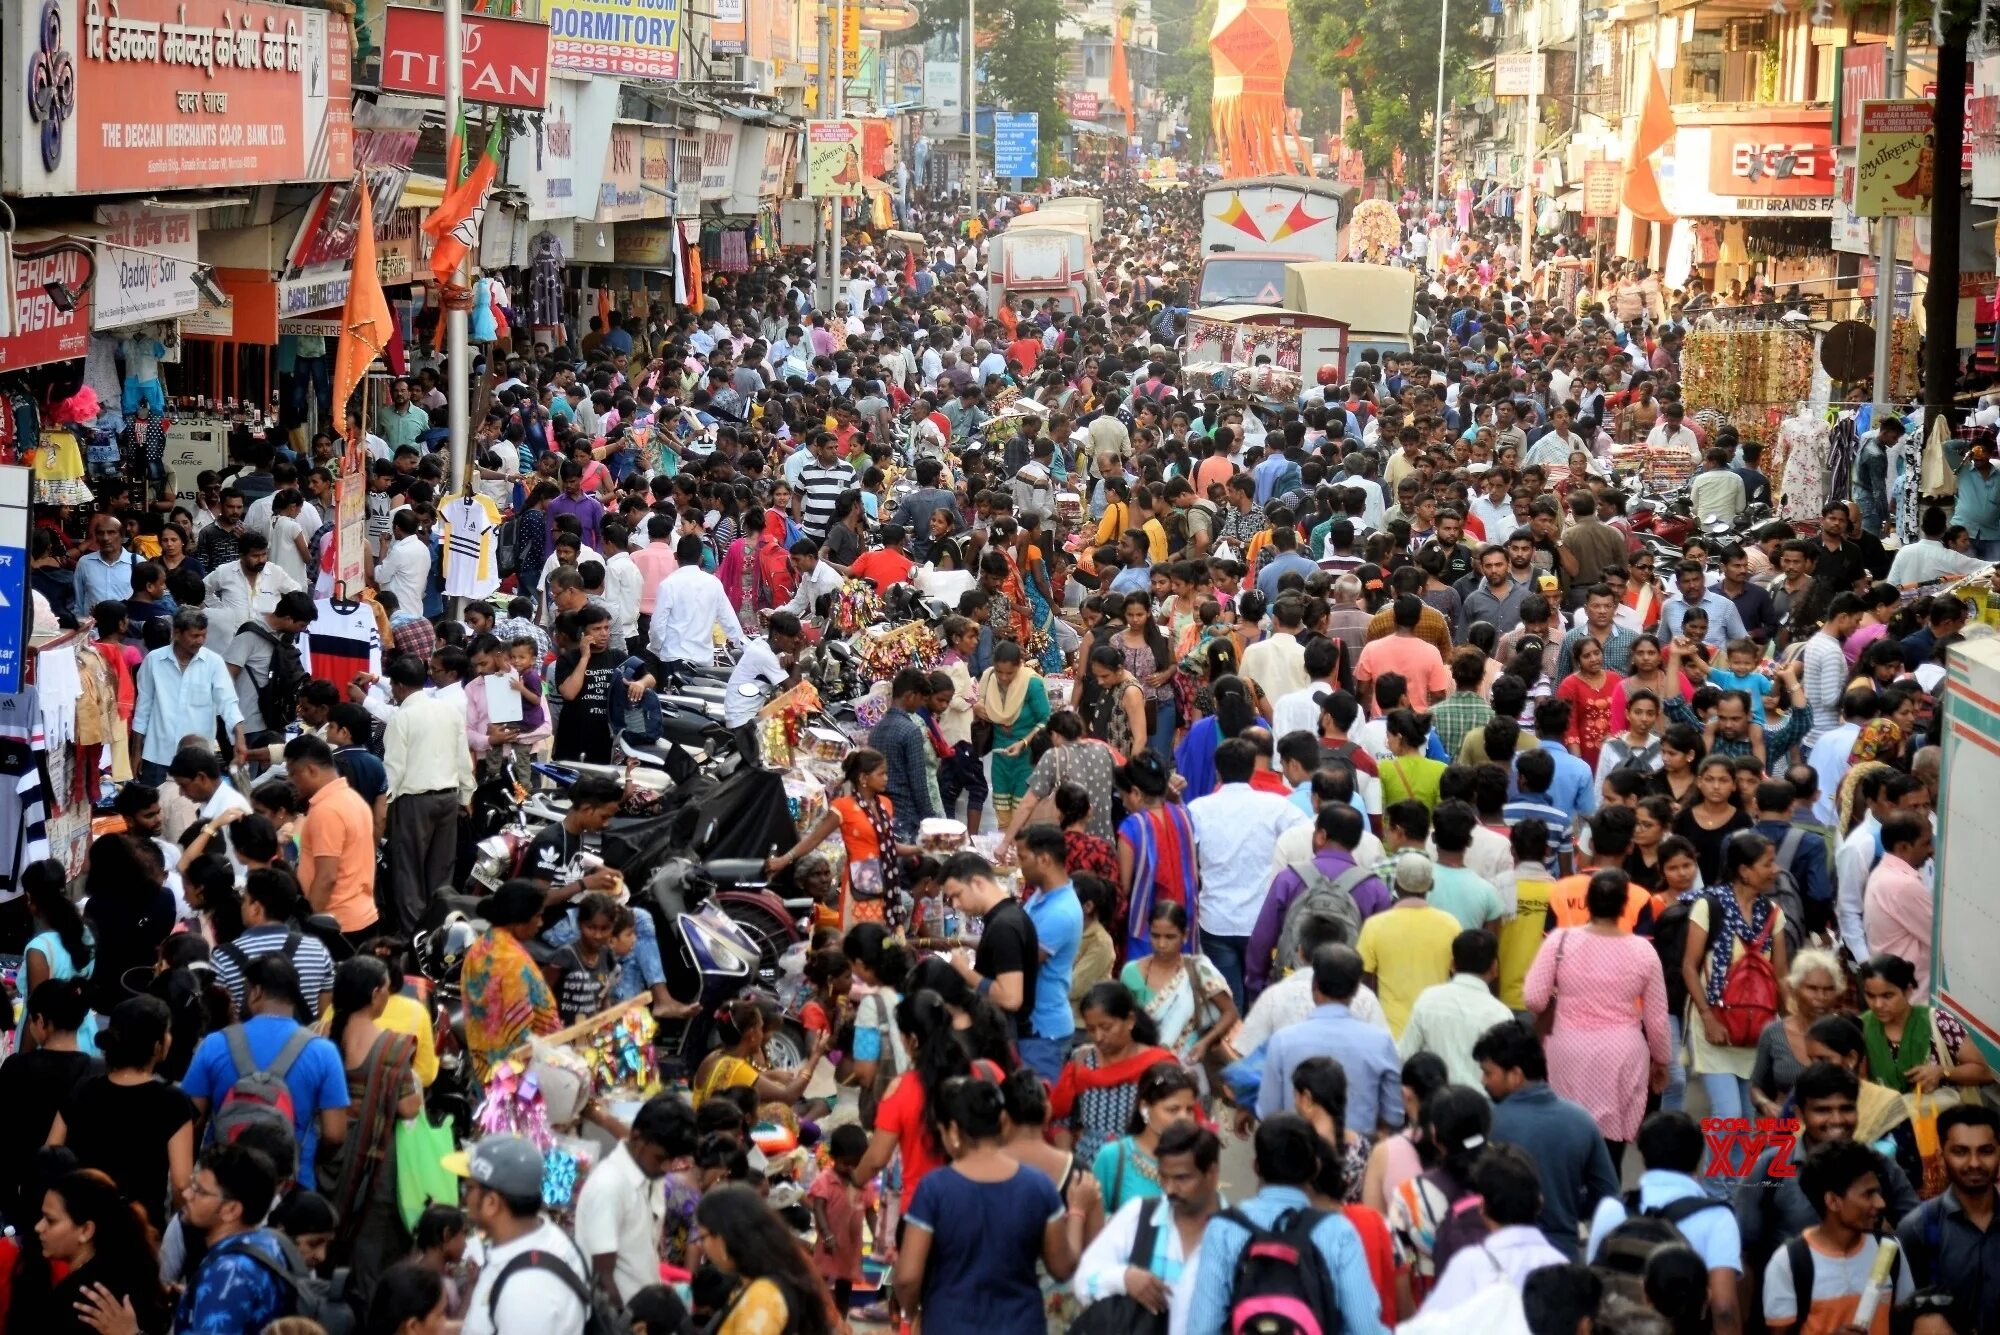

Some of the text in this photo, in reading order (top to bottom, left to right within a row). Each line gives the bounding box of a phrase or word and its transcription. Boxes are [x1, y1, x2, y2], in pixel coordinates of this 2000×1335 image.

[551, 7, 676, 47] DORMITORY
[389, 49, 541, 98] TITAN
[176, 90, 228, 113] दादर शाखा
[1072, 100, 1097, 110] Service
[1074, 92, 1096, 101] Watch
[1072, 109, 1096, 117] Centre
[102, 123, 121, 148] THE
[125, 123, 163, 148] DECCAN
[166, 124, 217, 147] MERCHANTS
[247, 124, 268, 146] BANK
[270, 124, 287, 145] LTD.
[1861, 138, 1920, 180] MAITREEN
[1737, 198, 1764, 210] MULTI
[1766, 199, 1816, 211] BRANDS
[13, 251, 78, 292] ERICAN
[121, 257, 150, 292] Daddy
[159, 257, 176, 282] Son
[304, 325, 341, 336] CENTRE
[585, 668, 614, 676] CRAFTING
